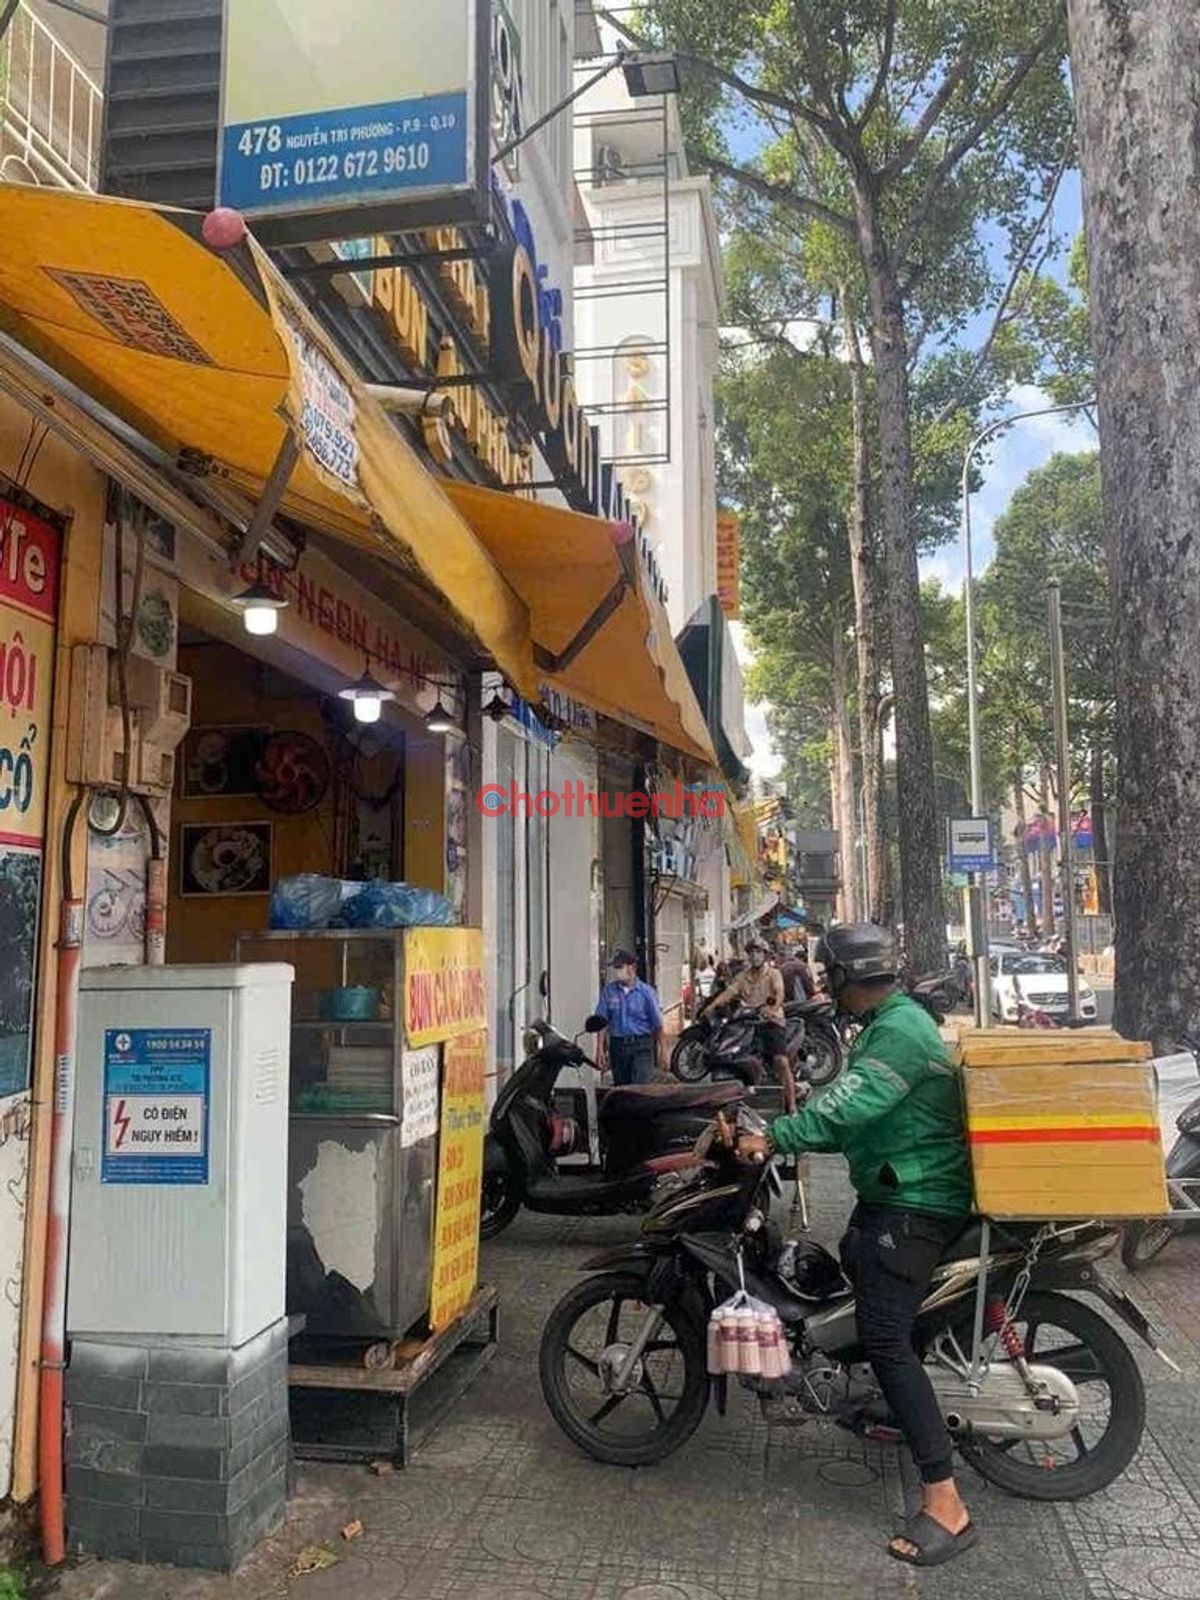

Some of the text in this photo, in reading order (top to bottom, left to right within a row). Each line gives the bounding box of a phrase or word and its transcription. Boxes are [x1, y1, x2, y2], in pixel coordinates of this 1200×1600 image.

[238, 124, 282, 157] 478
[260, 142, 430, 190] ĐT: 0122 672 9610
[0, 518, 46, 594] Te
[143, 1105, 188, 1122] CÓ ĐIỆN
[131, 1129, 162, 1143] NGUY
